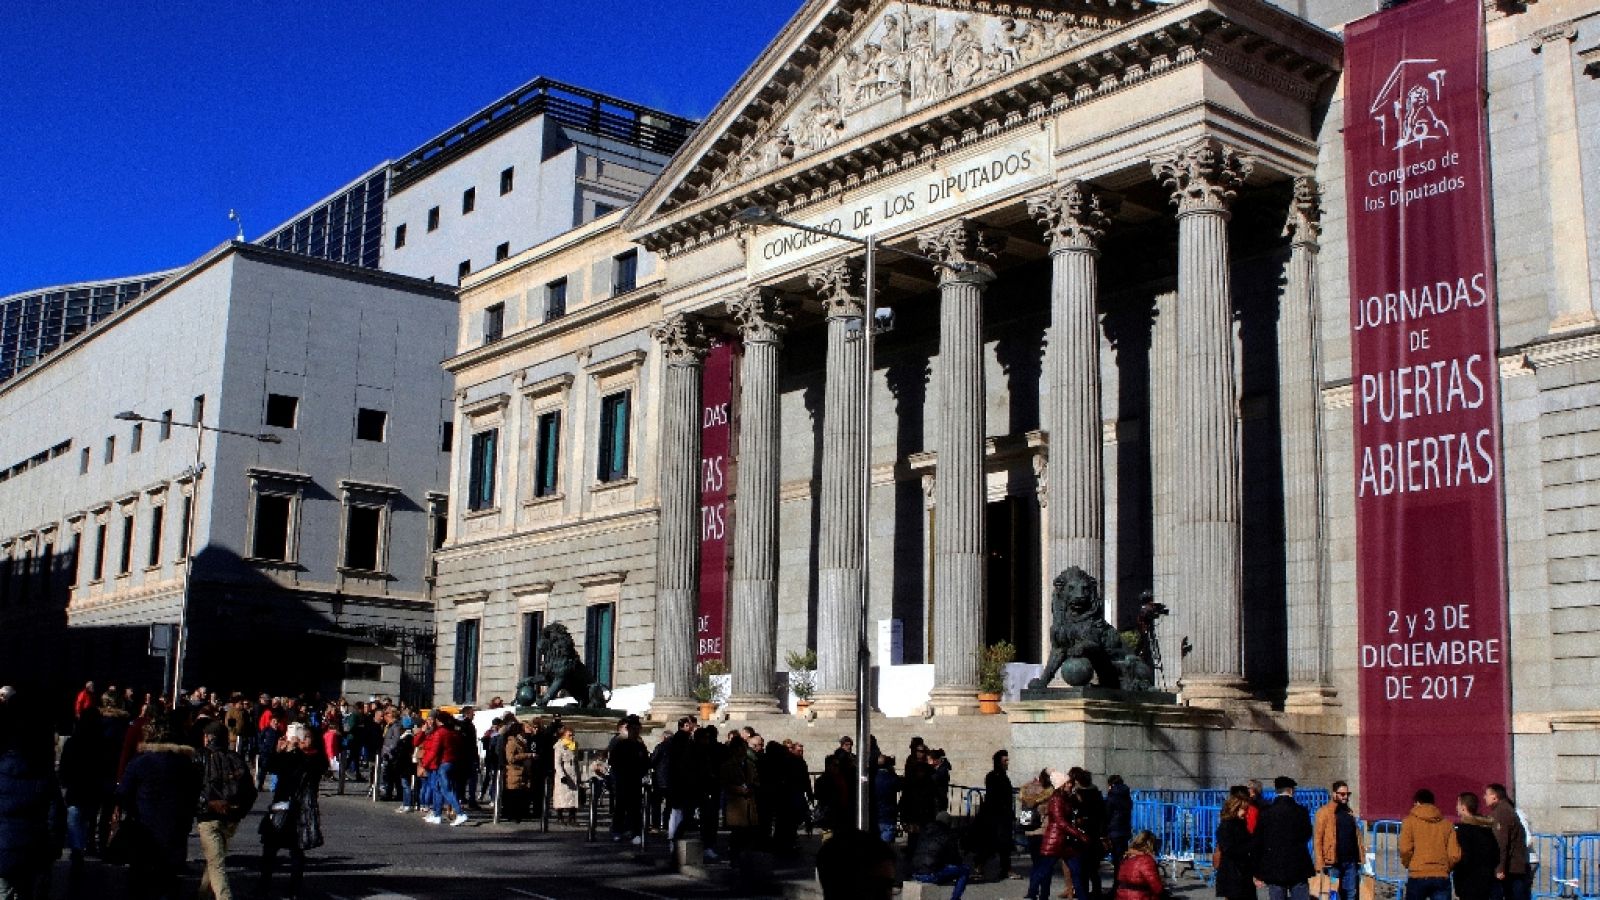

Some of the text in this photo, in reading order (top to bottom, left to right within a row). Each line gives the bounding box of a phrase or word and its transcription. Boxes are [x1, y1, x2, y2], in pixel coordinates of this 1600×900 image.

[1368, 151, 1459, 188] Congreso de
[763, 150, 1031, 261] CONGRESO DE LOS DIPUTADOS
[1364, 175, 1465, 212] los Diputados
[1354, 272, 1487, 331] JORNADAS
[1410, 328, 1431, 352] DE
[1361, 354, 1484, 425] PUERTAS
[1359, 428, 1493, 498] ABIERTAS
[1388, 604, 1470, 638] 2 y 3 DE
[697, 637, 721, 656] BRE
[1361, 639, 1500, 668] DICIEMBRE
[1385, 675, 1475, 700] DE 2017
